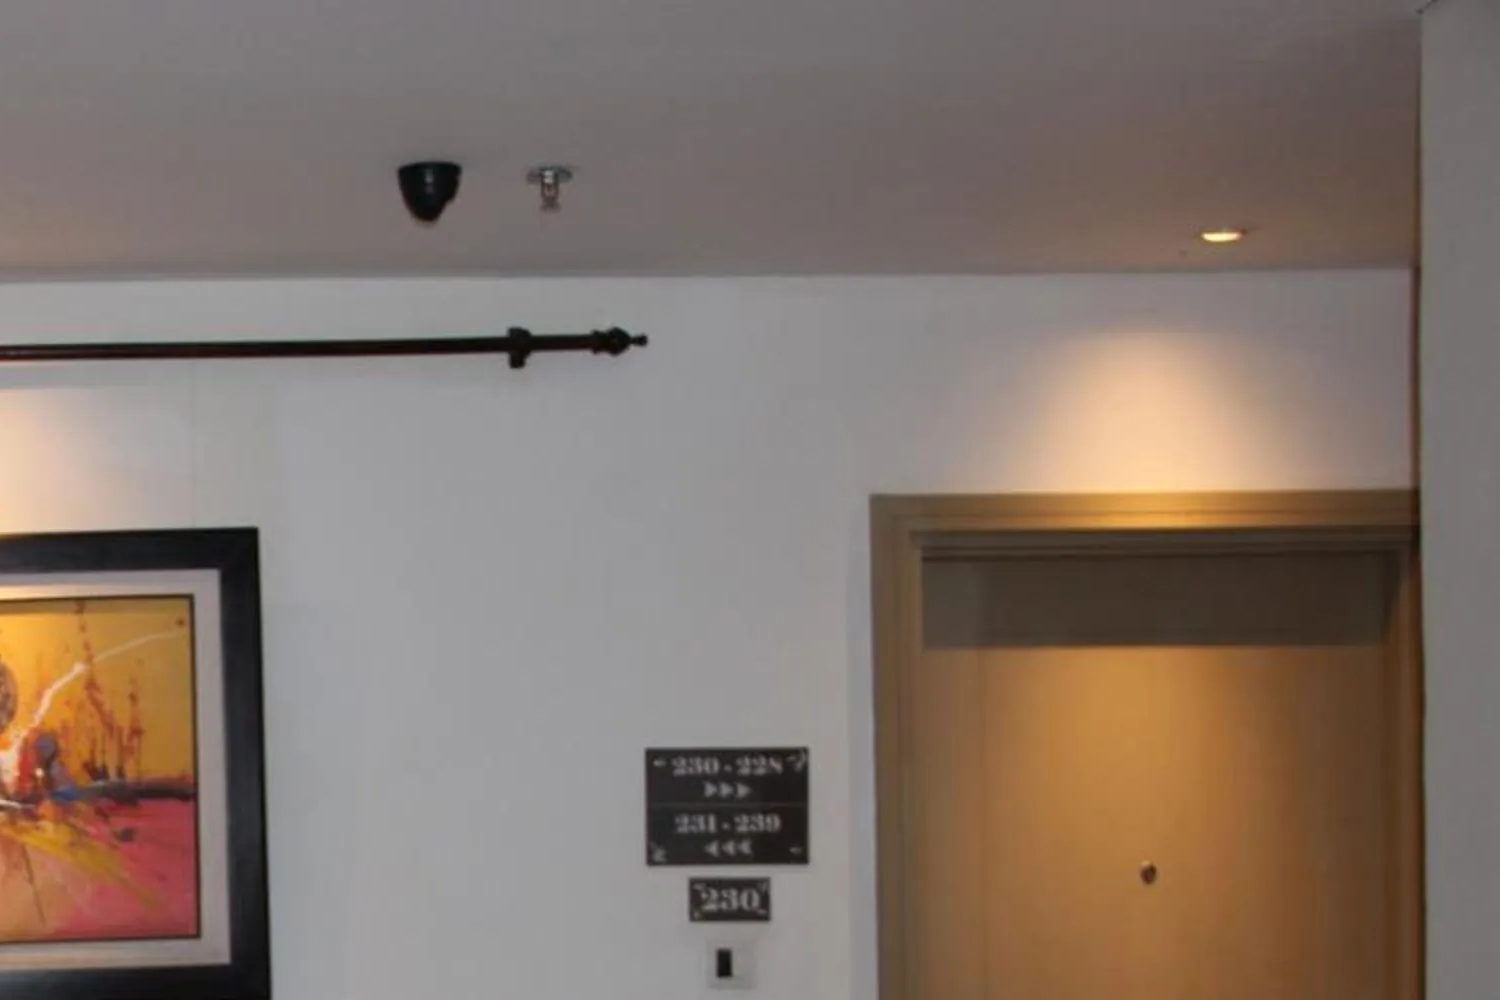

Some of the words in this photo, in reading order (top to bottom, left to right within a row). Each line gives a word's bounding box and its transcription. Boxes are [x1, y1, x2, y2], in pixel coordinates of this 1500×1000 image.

[671, 756, 720, 776] 230
[735, 755, 784, 775] 228
[674, 814, 717, 834] 231
[701, 888, 761, 912] 230
